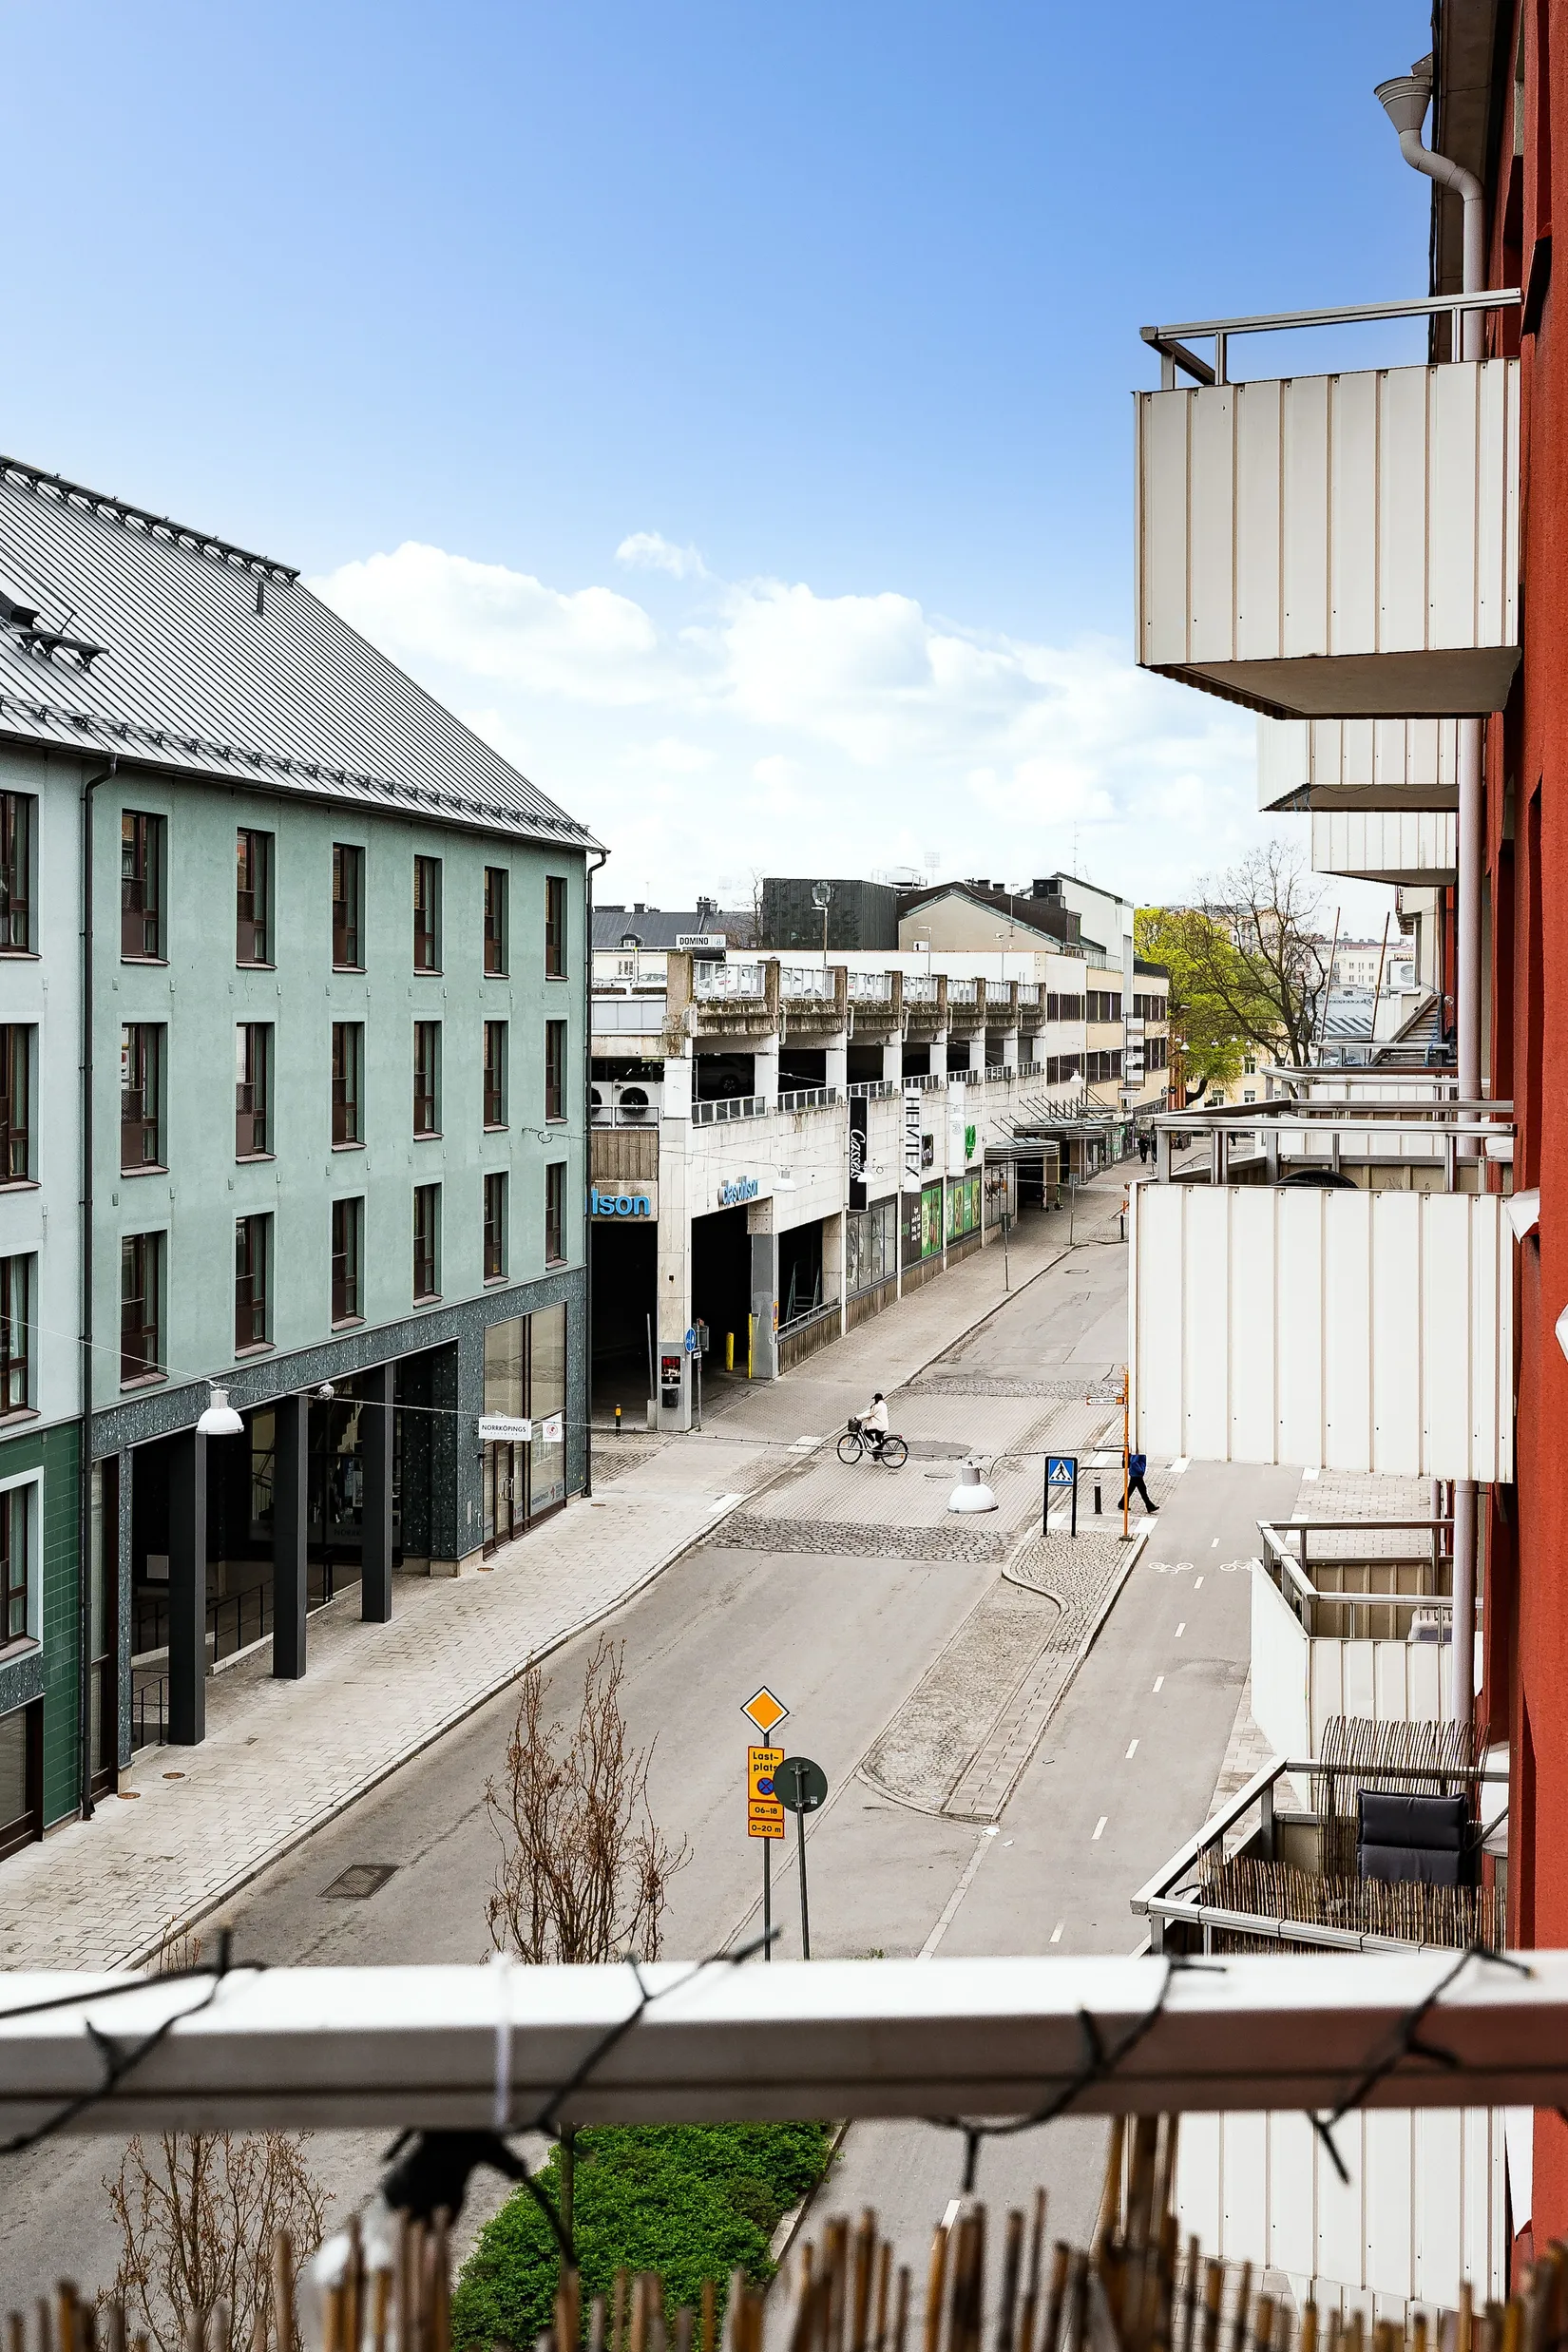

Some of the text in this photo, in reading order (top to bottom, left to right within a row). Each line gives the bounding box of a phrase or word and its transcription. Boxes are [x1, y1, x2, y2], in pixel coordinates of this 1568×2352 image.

[679, 937, 709, 946] DOMINO
[905, 1097, 920, 1178] HEMTEX
[850, 1128, 867, 1179] Cassels
[585, 1188, 651, 1215] lson
[482, 1425, 526, 1433] NORRKÖPINGS
[753, 1751, 779, 1761] Last-
[755, 1807, 777, 1815] 06-18
